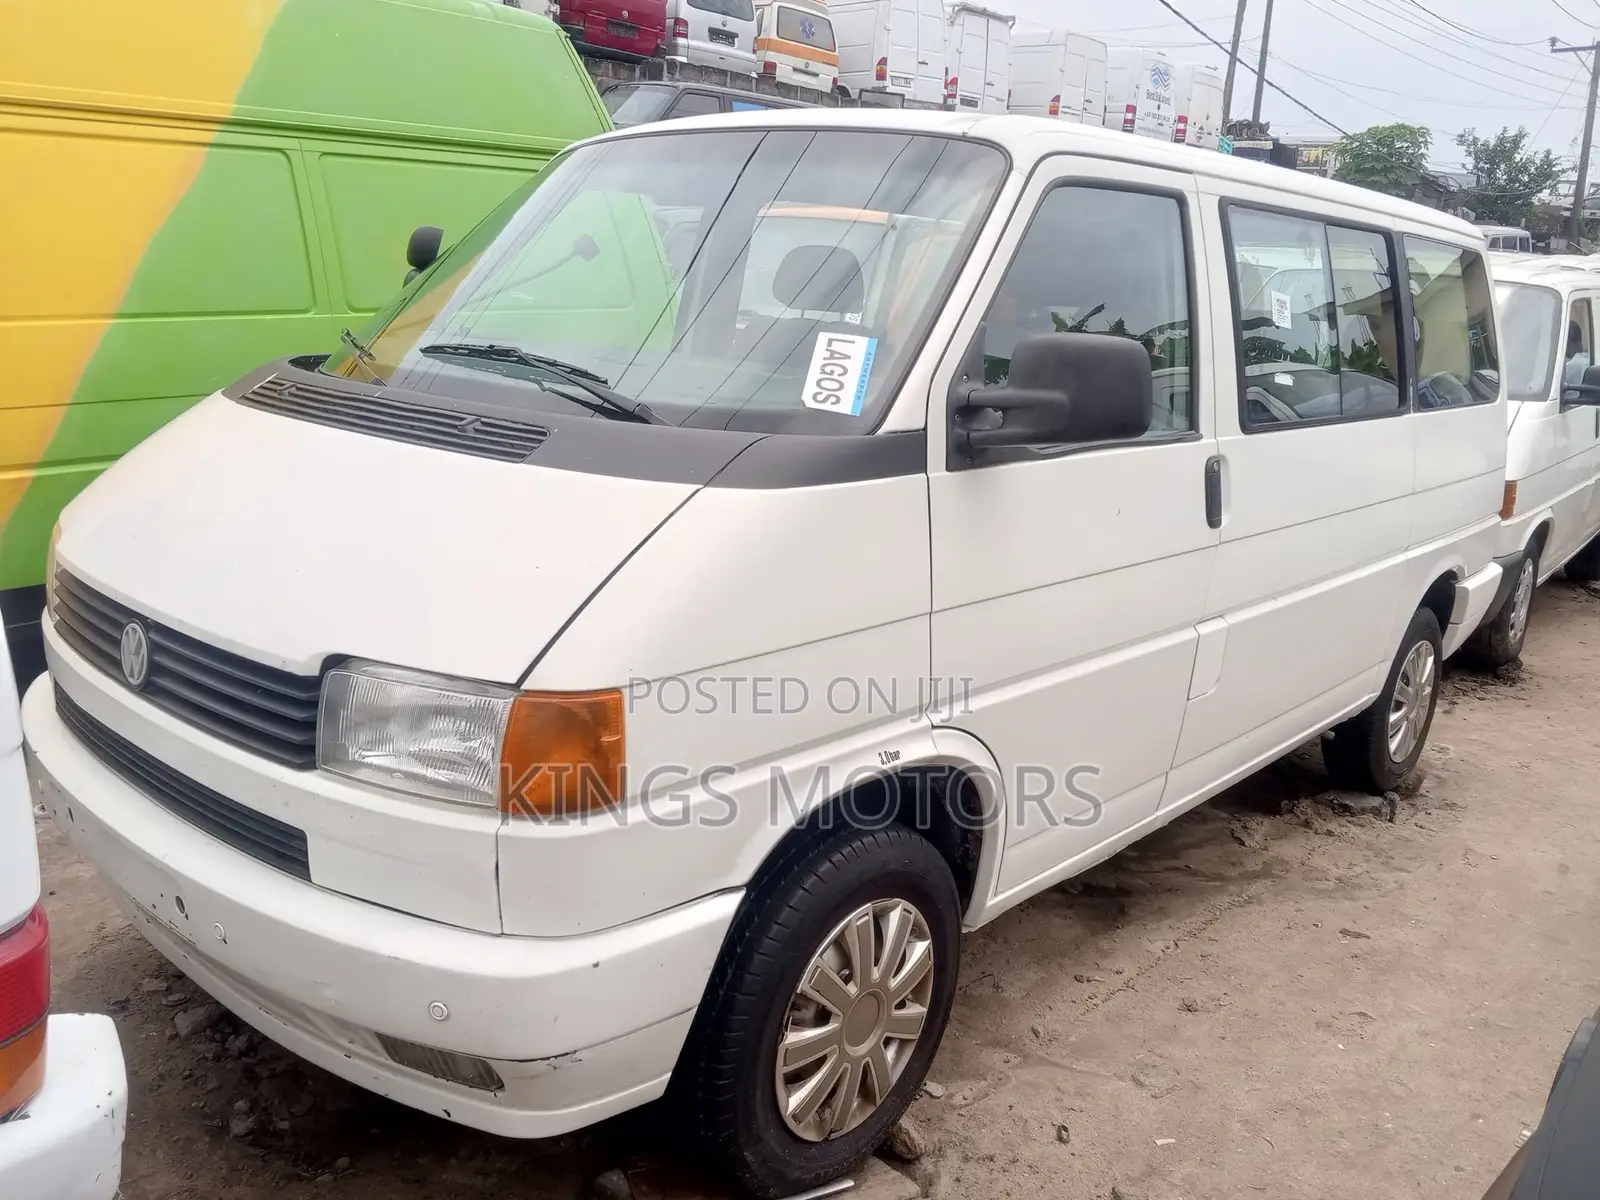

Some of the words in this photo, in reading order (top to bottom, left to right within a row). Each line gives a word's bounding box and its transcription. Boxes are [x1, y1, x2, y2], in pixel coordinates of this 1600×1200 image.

[812, 337, 856, 406] LAGOS
[856, 351, 873, 401] ANTWERPEN
[888, 750, 901, 762] bar
